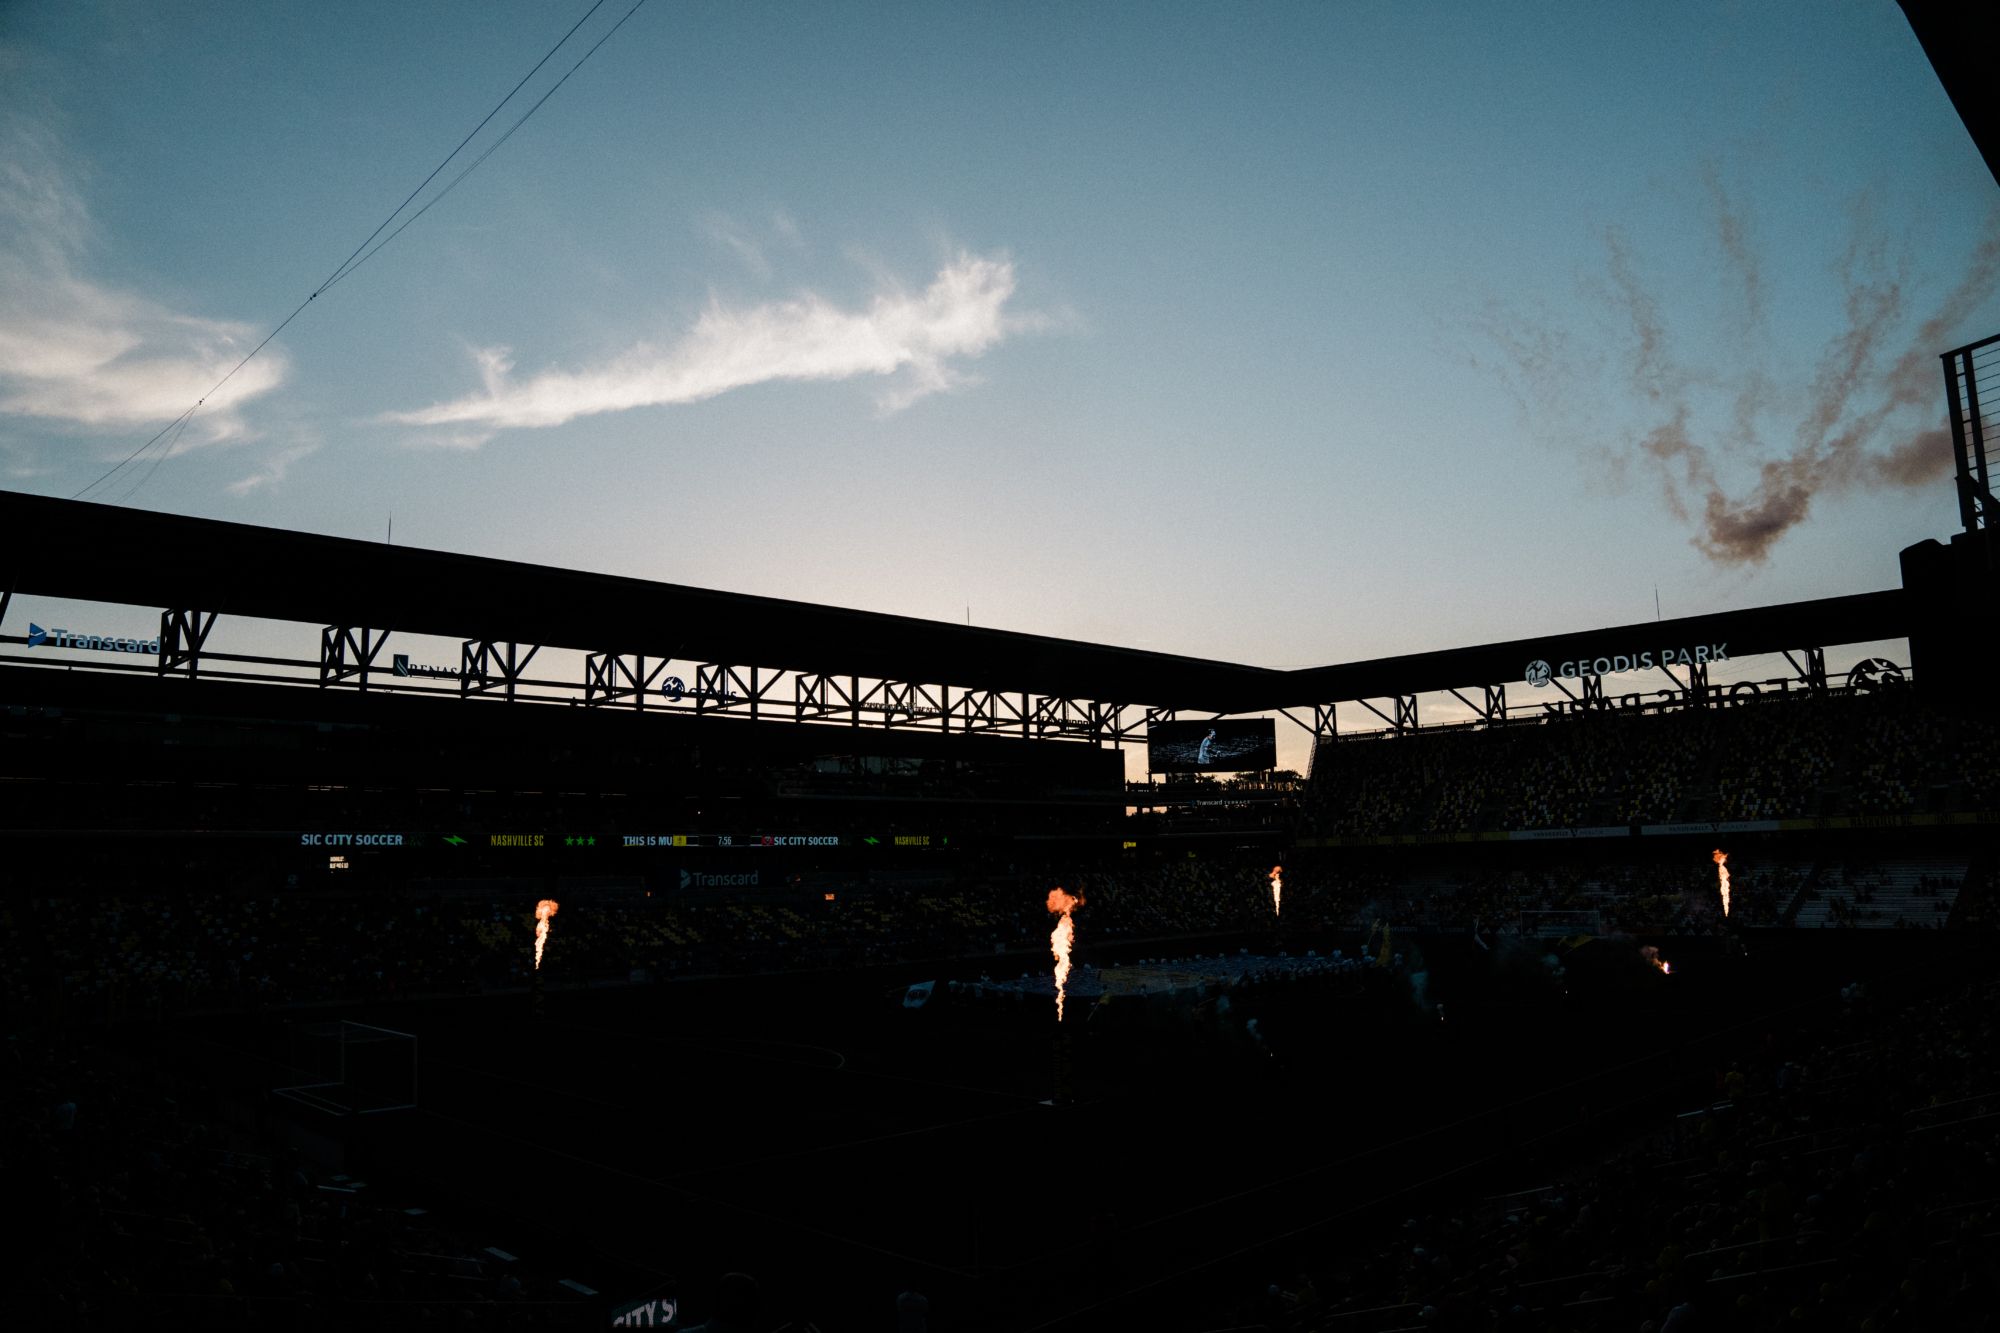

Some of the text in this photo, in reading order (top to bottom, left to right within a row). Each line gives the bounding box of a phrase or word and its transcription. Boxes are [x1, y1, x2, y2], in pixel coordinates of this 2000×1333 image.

[51, 628, 161, 655] Transcard
[1559, 642, 1730, 680] GEODIS PARK
[301, 834, 403, 846] SIC CITY SOCCER
[490, 834, 545, 847] NASHVILLE SC
[622, 835, 645, 846] THIS
[647, 835, 656, 846] IS
[773, 836, 839, 846] SIC CITY SOCCER
[894, 836, 922, 846] NASHVILLE
[692, 869, 759, 887] Transcard
[661, 1298, 677, 1323] S
